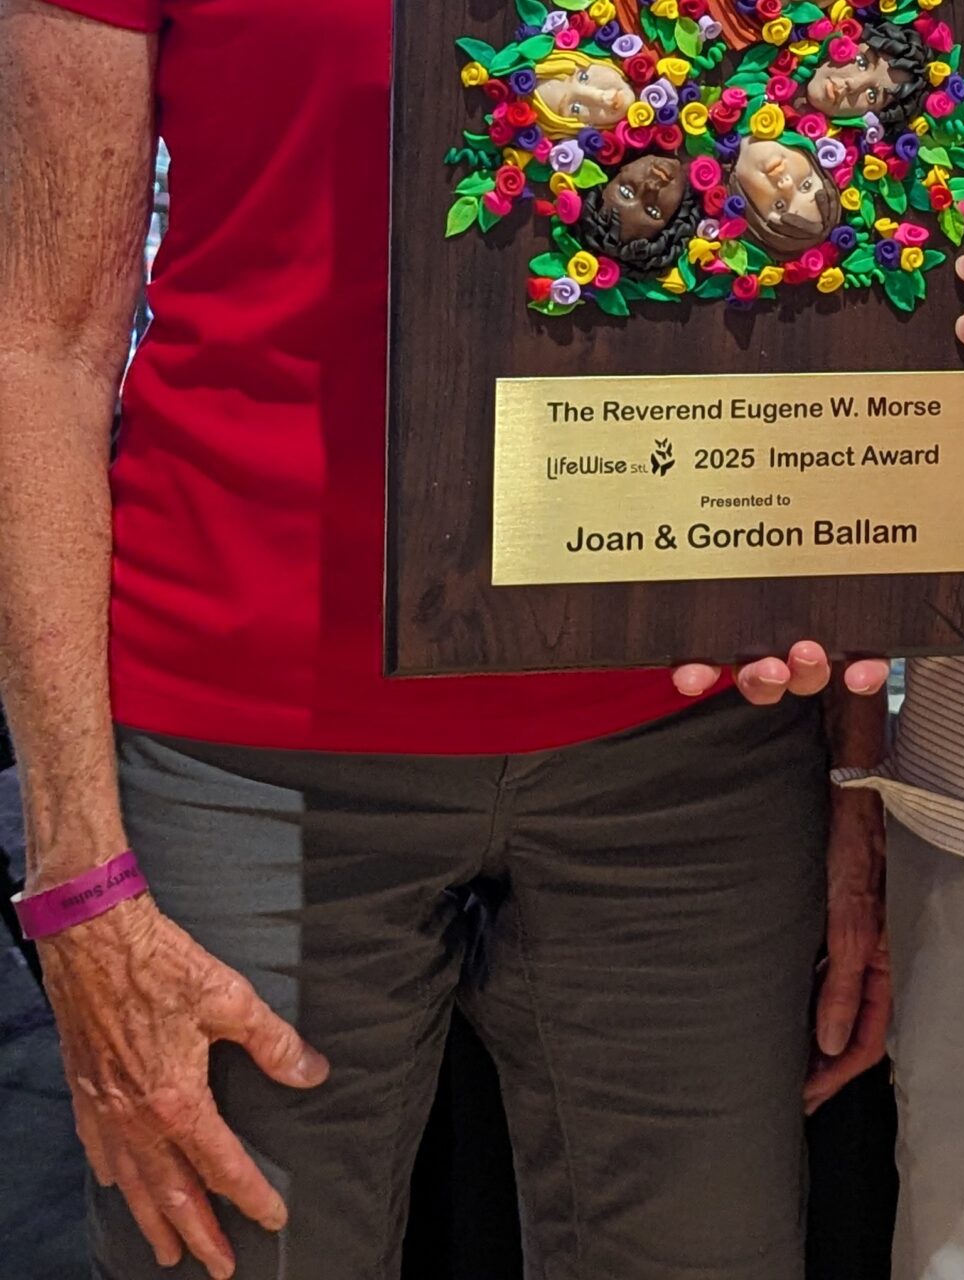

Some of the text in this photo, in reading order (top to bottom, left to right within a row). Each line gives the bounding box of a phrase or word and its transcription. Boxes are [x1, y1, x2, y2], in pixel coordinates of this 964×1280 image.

[547, 396, 942, 424] The Reverend Eugene W. Morse
[547, 455, 627, 480] LifeWise
[694, 448, 756, 470] 2025
[769, 446, 856, 473] Impact
[860, 443, 940, 466] Award
[700, 494, 791, 508] Presented to
[566, 518, 918, 553] Joan & Gordon Ballam
